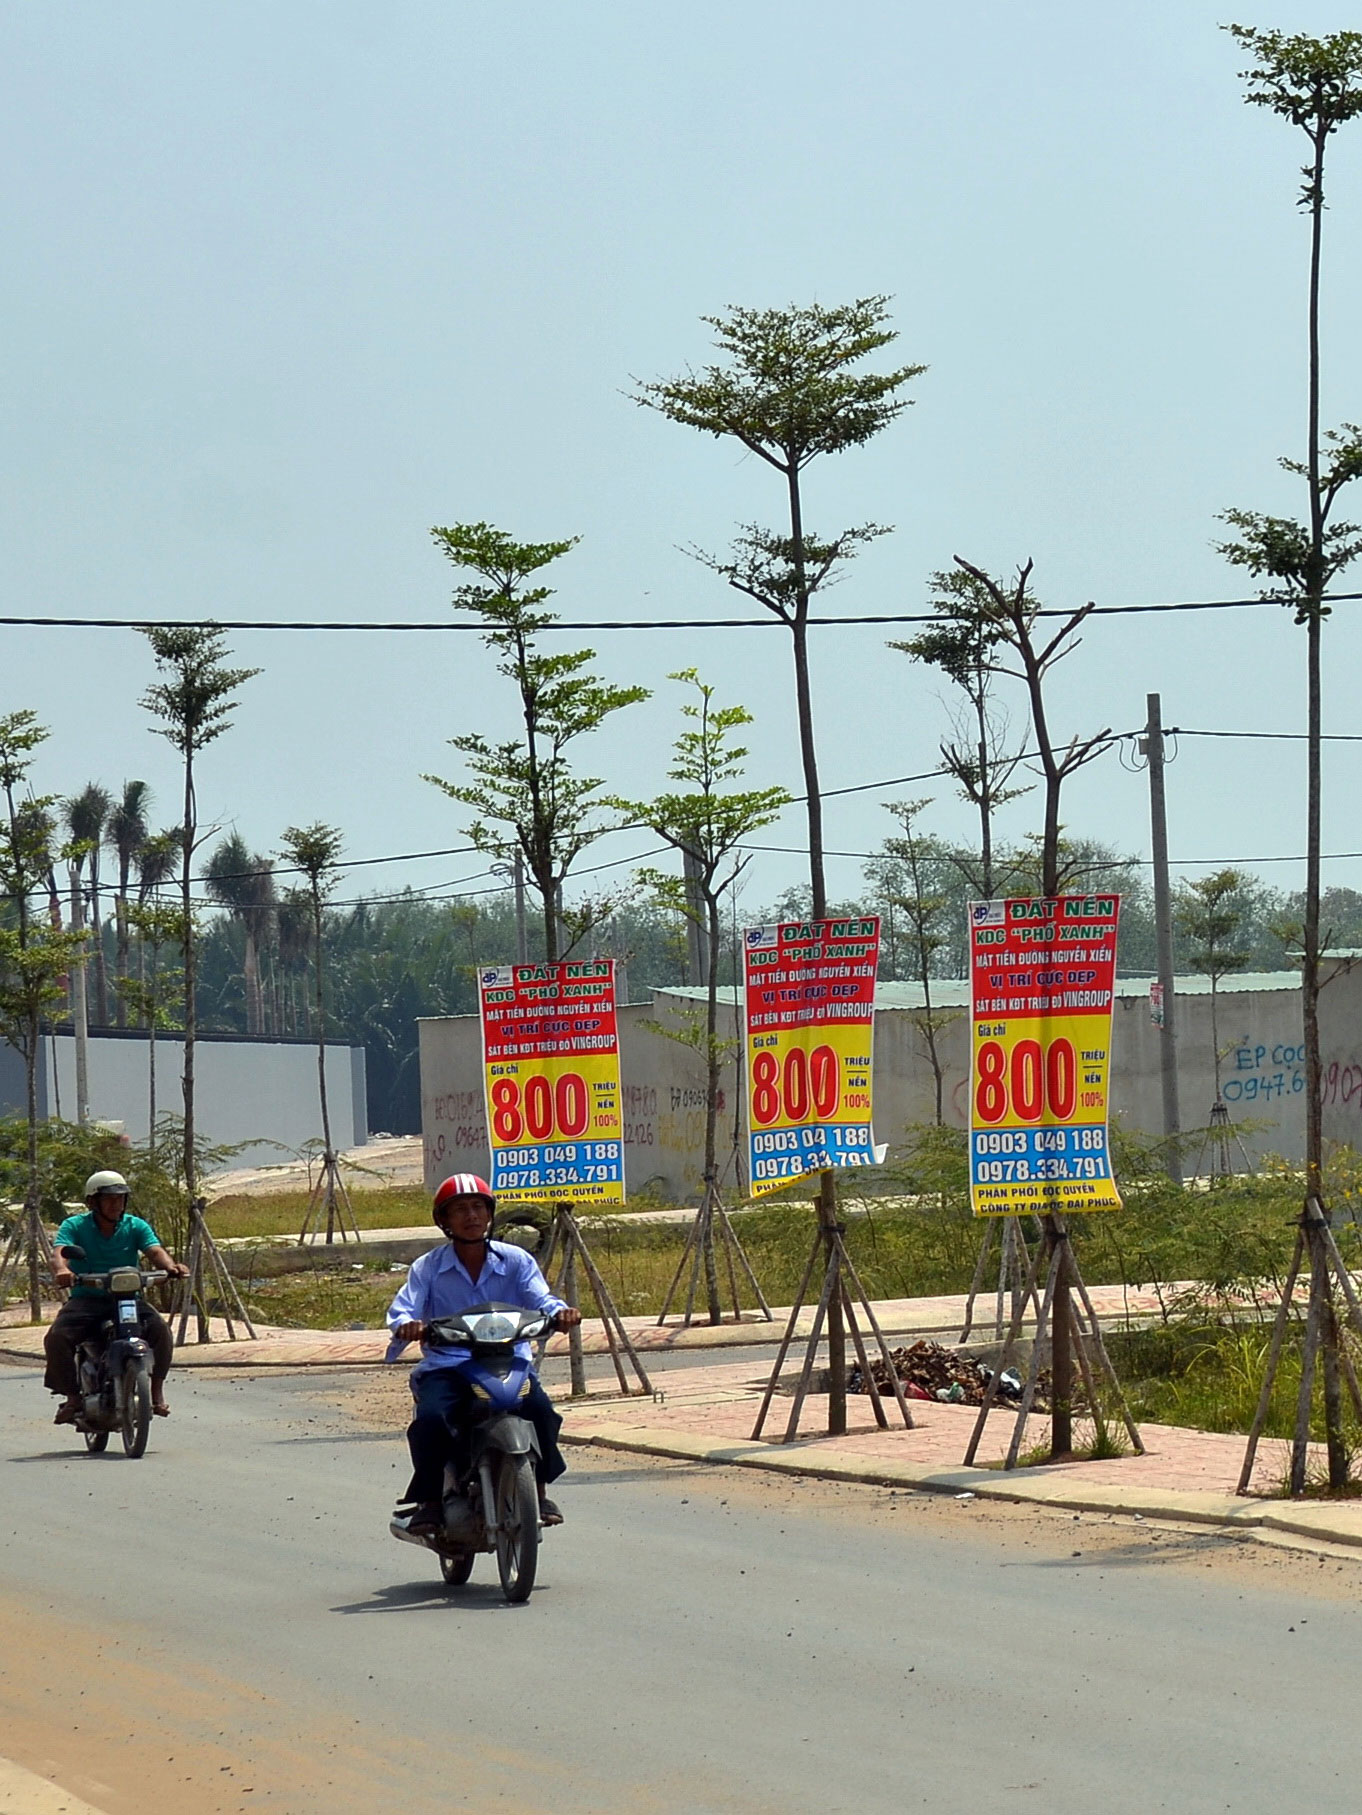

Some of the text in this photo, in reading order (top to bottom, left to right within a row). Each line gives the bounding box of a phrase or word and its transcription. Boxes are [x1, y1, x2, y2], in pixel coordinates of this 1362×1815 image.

[976, 929, 1006, 945] KDC
[749, 951, 778, 966] KDC
[1008, 970, 1032, 987] TRÍ
[485, 990, 515, 1003] KDC
[779, 986, 801, 1002] TRÍ
[976, 997, 990, 1012] SÁT
[1063, 990, 1111, 1008] VINGROUP
[750, 1013, 762, 1027] SÁT
[826, 1002, 873, 1018] VINGROUP
[518, 1021, 539, 1034] TRÍ
[488, 1044, 501, 1056] SÁT
[571, 1034, 616, 1050] VINGROUP
[752, 1044, 840, 1126] 800
[976, 1037, 1076, 1123] 800
[1223, 1070, 1304, 1101] 0947.6
[491, 1072, 590, 1143] 800
[843, 1094, 870, 1108] 100%
[1080, 1092, 1104, 1107] 100%
[593, 1114, 618, 1127] 100%
[753, 1131, 798, 1154] 0903
[832, 1128, 869, 1146] 188
[976, 1129, 1103, 1154] 0903 049 188
[497, 1143, 619, 1168] 0903 049 188
[497, 1164, 617, 1189] 0978.334.791
[977, 1157, 1105, 1182] 0978.334.791
[1014, 1202, 1026, 1212] TY
